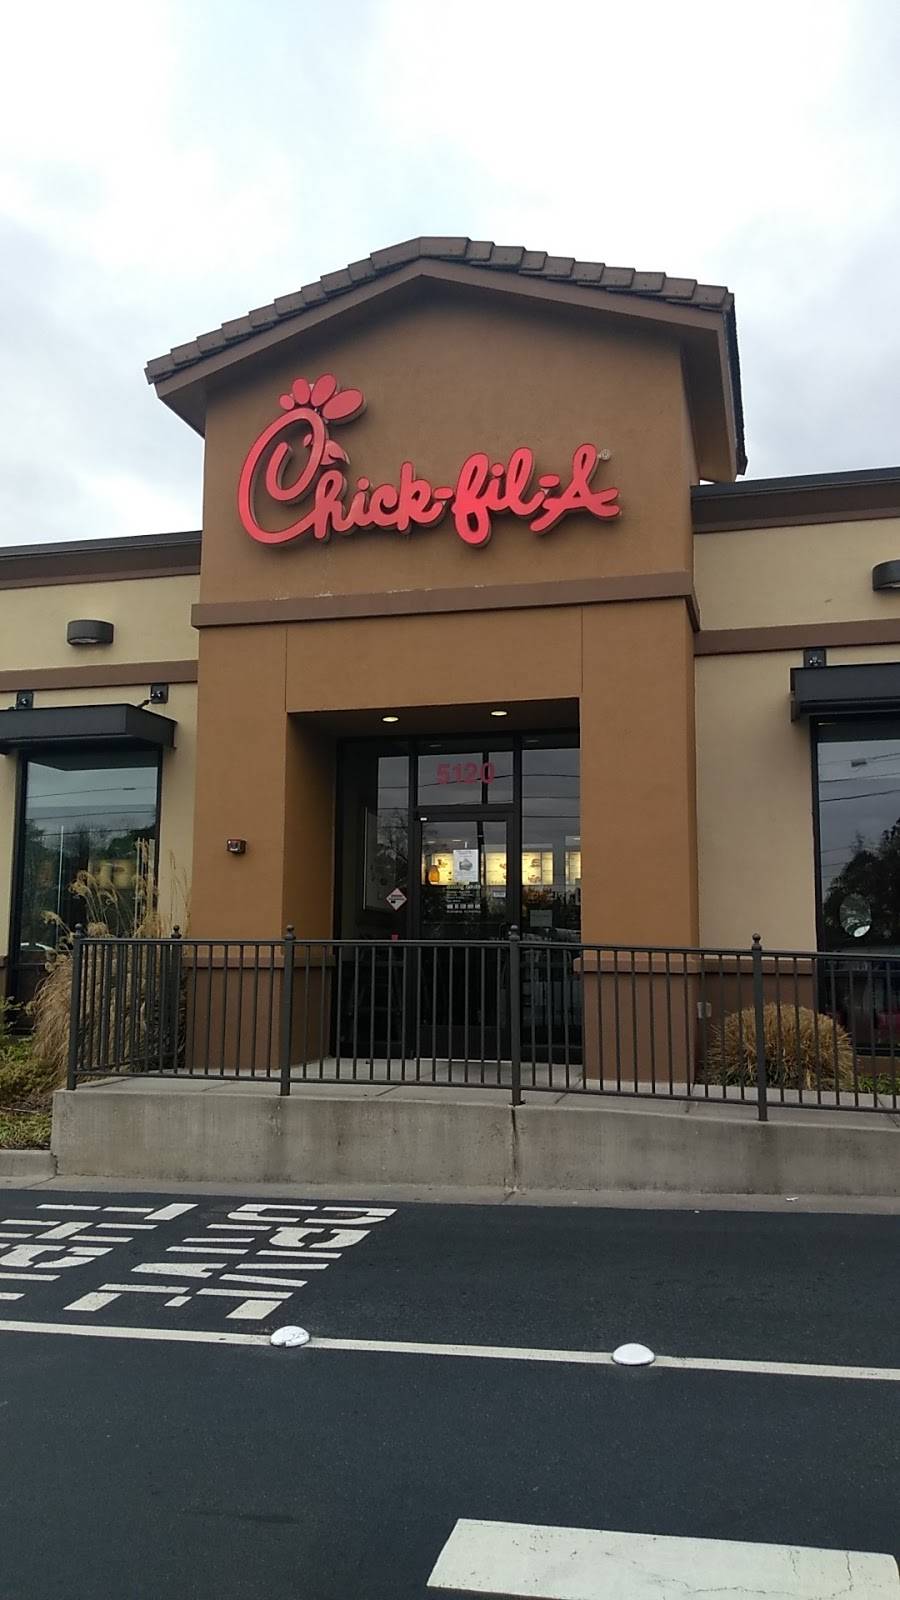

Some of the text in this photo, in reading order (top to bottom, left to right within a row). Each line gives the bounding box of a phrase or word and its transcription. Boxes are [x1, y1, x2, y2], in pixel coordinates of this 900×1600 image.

[238, 406, 620, 545] Chick-fil-A
[436, 762, 496, 784] 5120
[0, 1203, 199, 1301] THR
[63, 1203, 398, 1320] DRIVE
